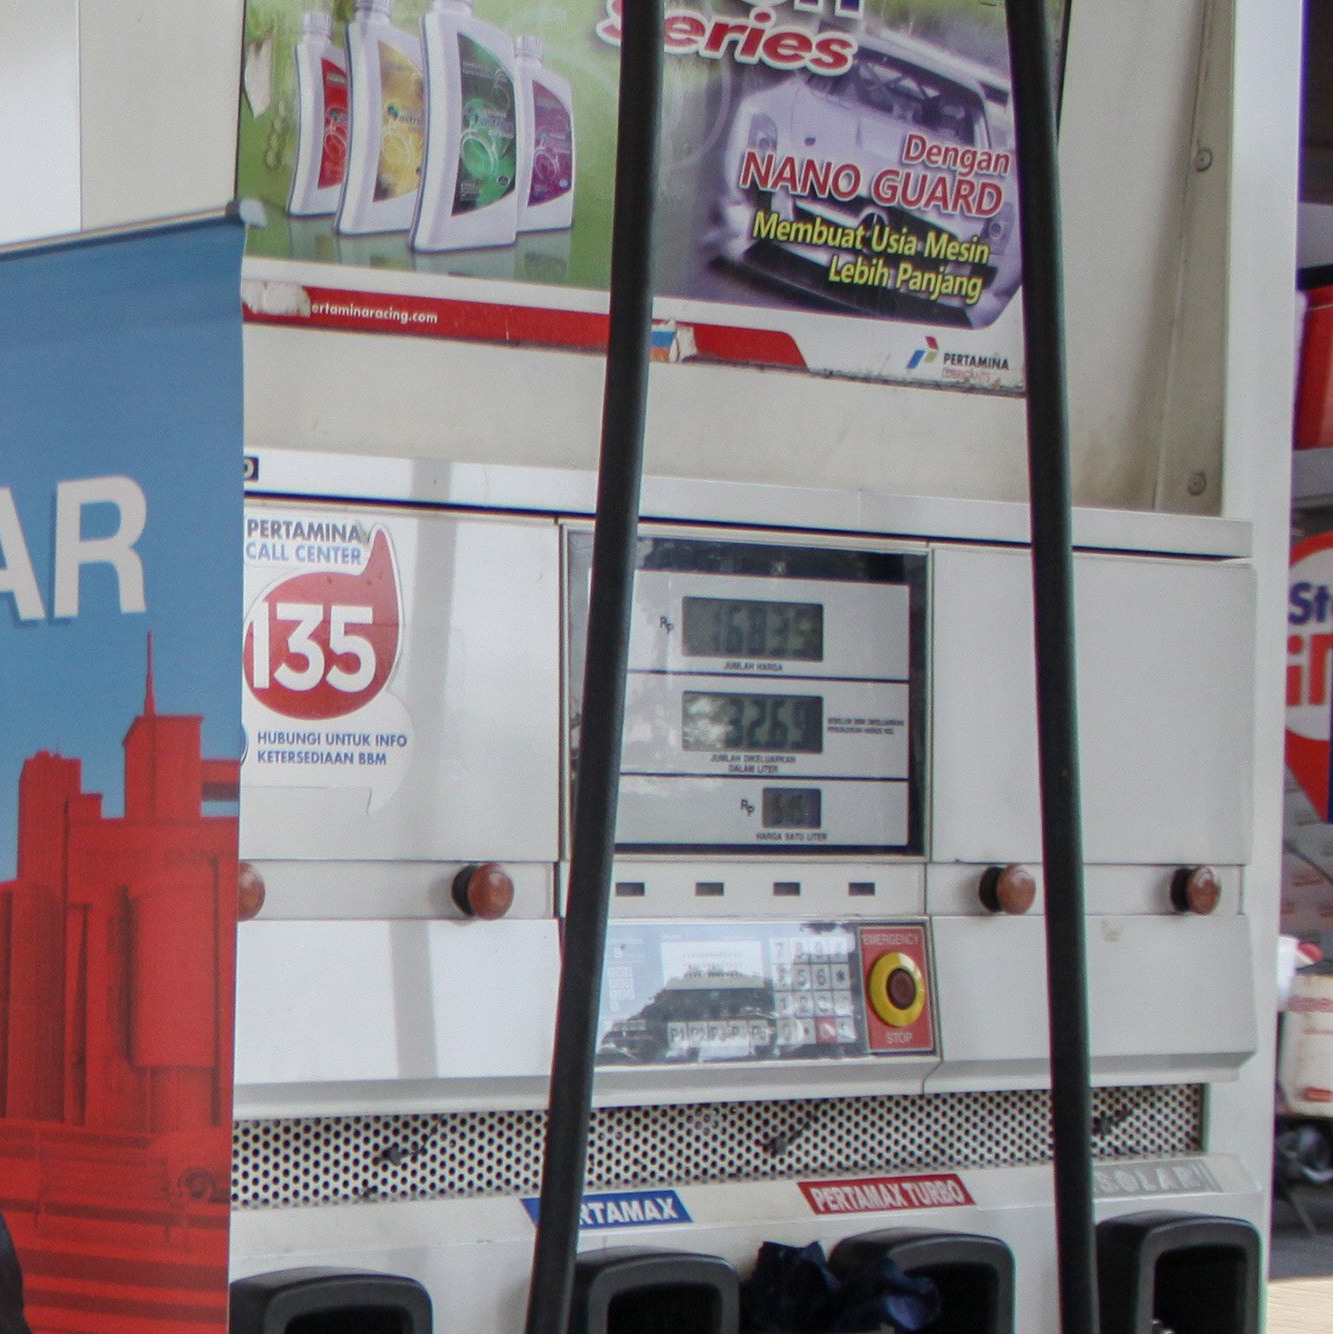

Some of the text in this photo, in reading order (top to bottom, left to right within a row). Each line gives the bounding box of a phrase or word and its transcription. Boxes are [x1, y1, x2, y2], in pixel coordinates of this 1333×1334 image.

[903, 133, 1011, 176] Dengan
[740, 151, 1003, 217] NANO GUARD
[752, 210, 991, 265] Membuat Usia Mesin
[828, 257, 983, 304] Lebih Panjang
[312, 302, 438, 324] ertaminaracing.com
[943, 352, 1009, 370] PERTAMINA
[247, 519, 362, 543] PERTAMINA
[245, 542, 362, 565] CALL CENTER
[659, 615, 674, 634] Rp
[248, 602, 377, 693] 135
[257, 731, 407, 748] HUBUNGI UNTUK INFO
[257, 750, 387, 765] KETERSEDIAAN BBM
[861, 933, 920, 945] EMERGENCY
[885, 1032, 914, 1044] STOP
[809, 1179, 966, 1212] PERTAMAX TURBO
[579, 1197, 679, 1225] RTAMAX
